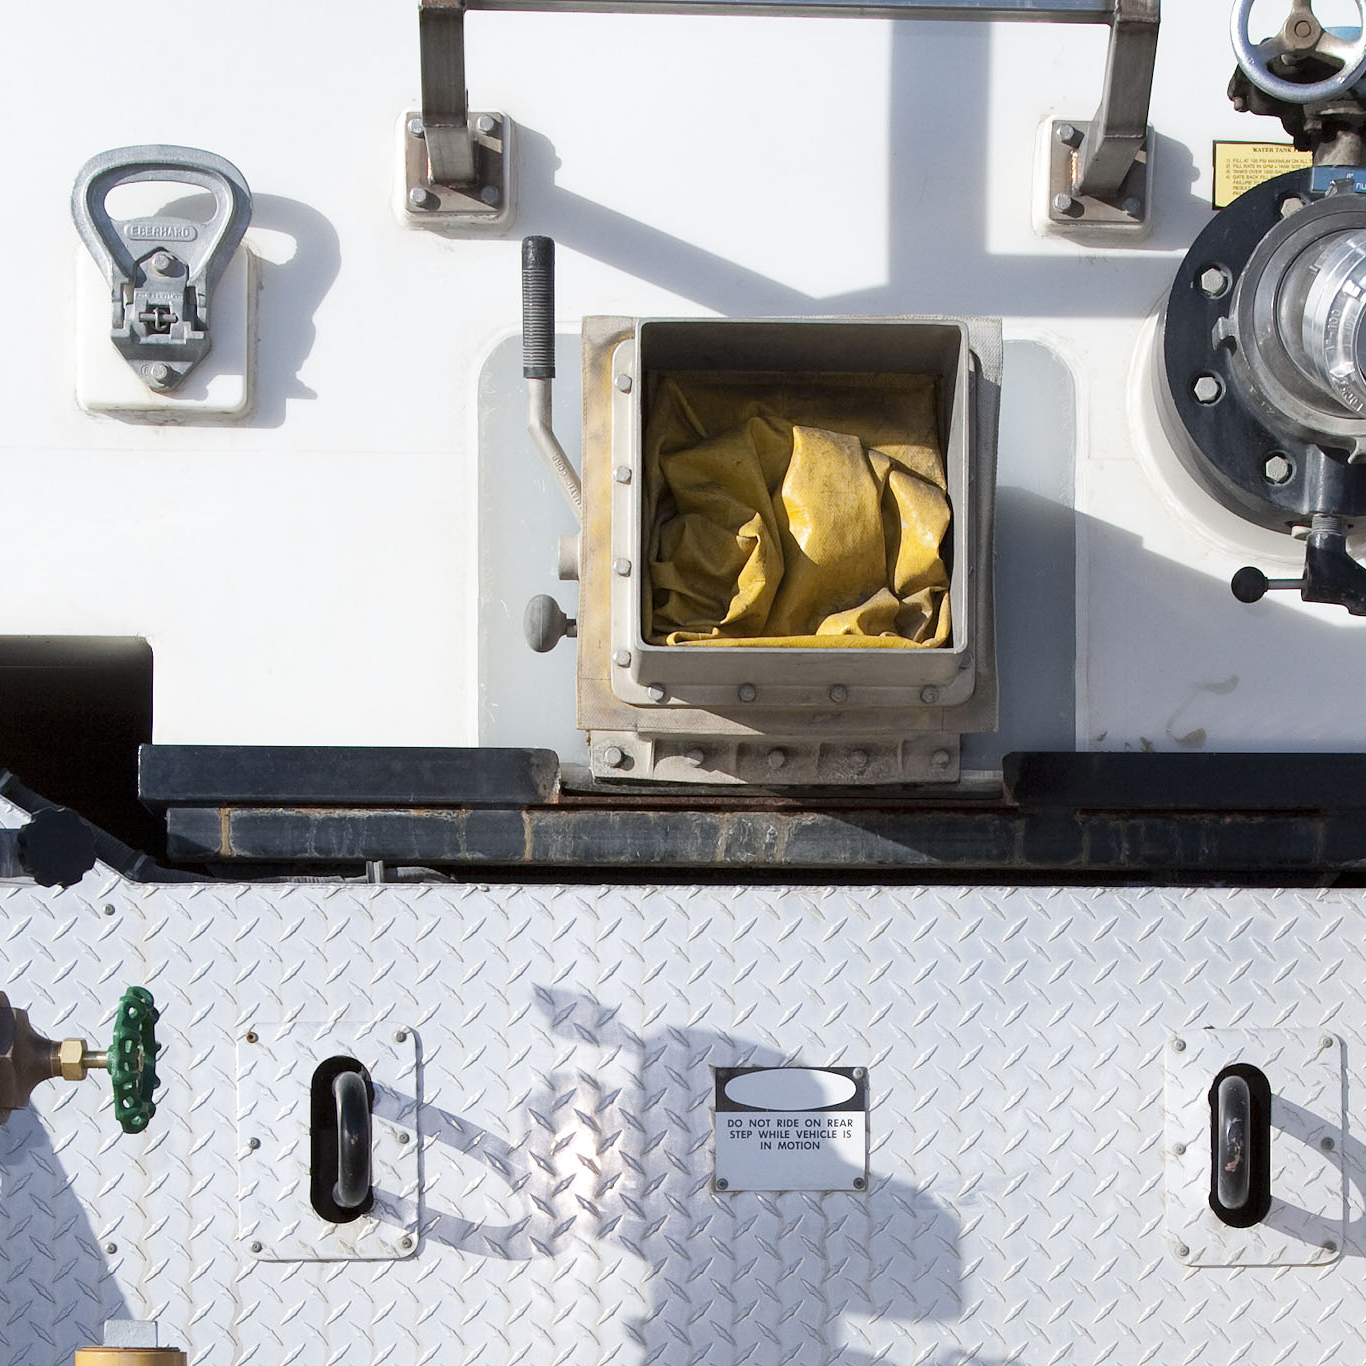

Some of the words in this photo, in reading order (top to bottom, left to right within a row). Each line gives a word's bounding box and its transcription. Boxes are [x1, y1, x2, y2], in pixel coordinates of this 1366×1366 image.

[130, 225, 191, 238] EBERHARD
[728, 1119, 742, 1128] DO
[749, 1119, 771, 1128] NOT
[777, 1119, 799, 1128] RIDE
[805, 1119, 821, 1128] ON
[828, 1119, 853, 1128] REAR
[730, 1130, 753, 1139] STEP
[759, 1130, 790, 1139] WHILE
[796, 1130, 836, 1139] VEHICLE
[843, 1130, 852, 1139] IS
[761, 1141, 772, 1150] IN
[778, 1141, 820, 1150] MOTION
